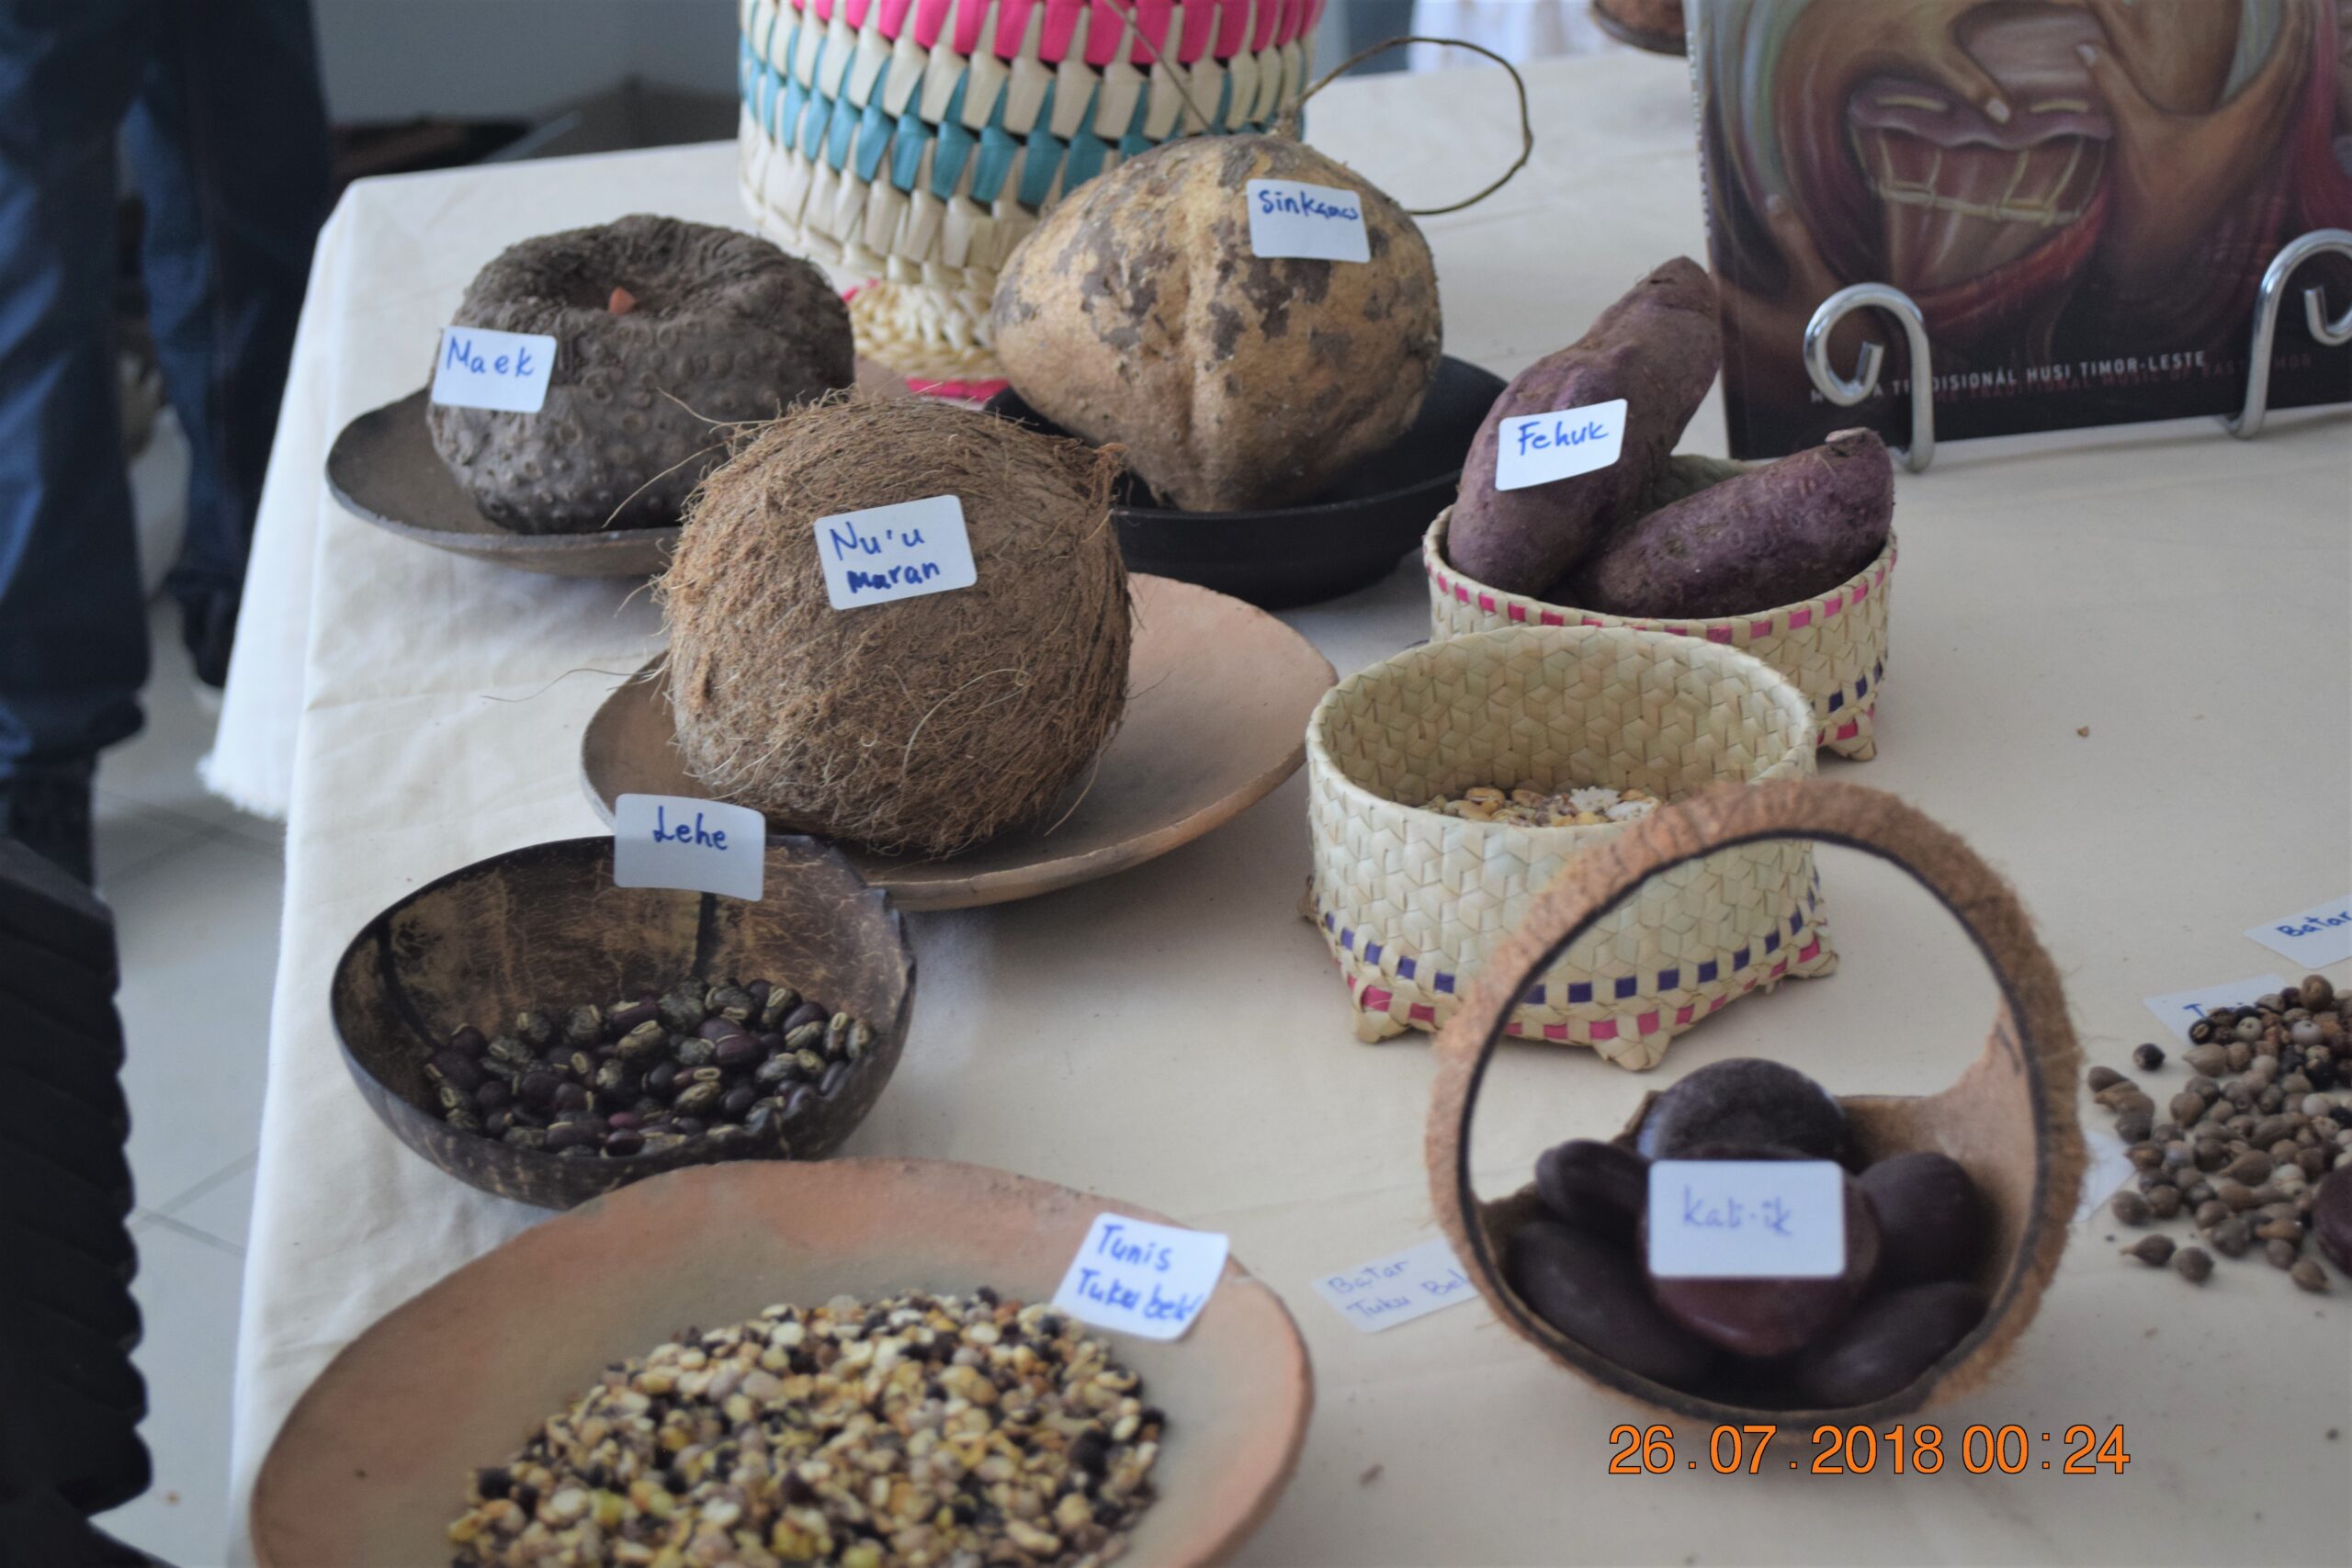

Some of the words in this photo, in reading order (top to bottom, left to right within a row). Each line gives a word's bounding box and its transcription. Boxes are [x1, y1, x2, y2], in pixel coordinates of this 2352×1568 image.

[447, 335, 535, 378] Maek
[2026, 363, 2071, 384] HUSI
[2079, 350, 2205, 378] TIMOR-LESTE
[1518, 421, 1609, 456] Fehuk
[652, 806, 729, 851] Lehe
[1097, 1224, 1172, 1271] Tunis
